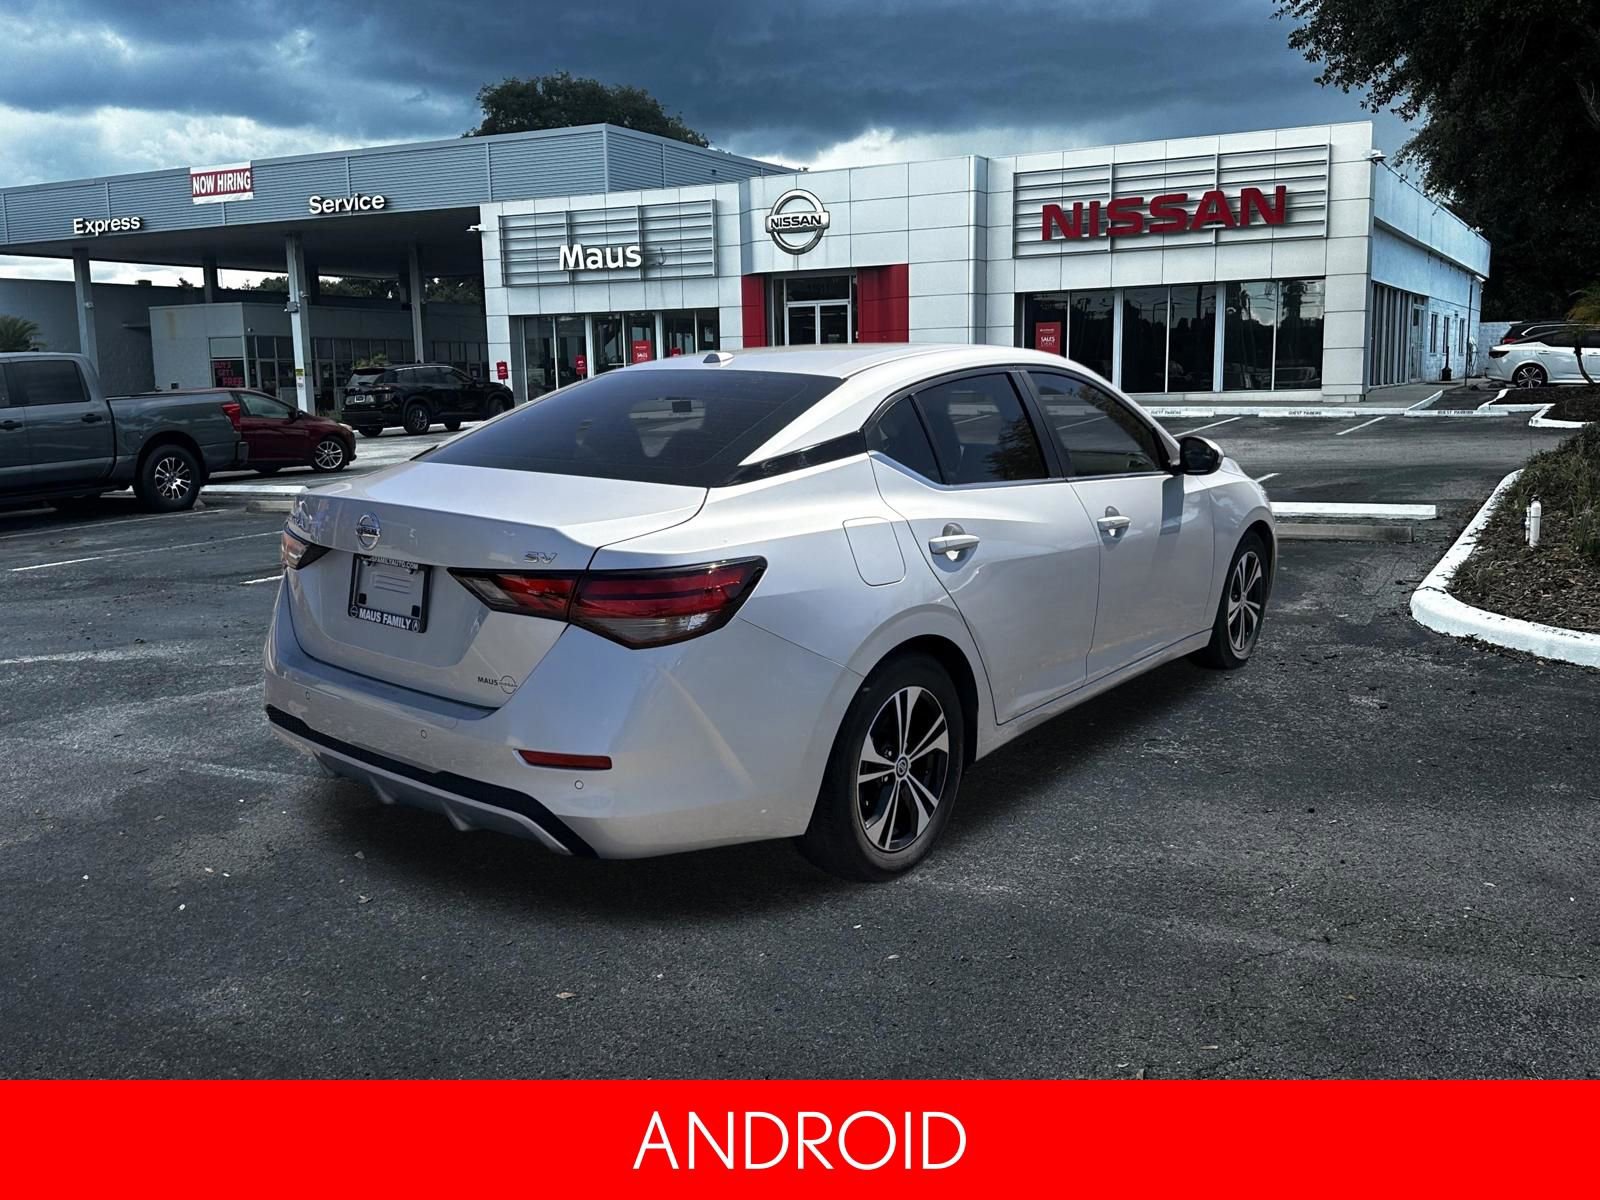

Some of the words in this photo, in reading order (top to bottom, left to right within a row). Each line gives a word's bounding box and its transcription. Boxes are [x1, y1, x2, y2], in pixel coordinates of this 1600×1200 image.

[192, 174, 215, 195] NOW
[217, 170, 251, 193] HIRING
[308, 193, 386, 215] Service
[1041, 185, 1287, 242] NISSAN
[72, 214, 142, 237] Express
[770, 214, 822, 228] NISSAN
[559, 243, 642, 271] Maus
[524, 551, 558, 564] SV
[359, 607, 382, 623] MAUS
[382, 613, 412, 630] FAMILY
[477, 676, 499, 686] MAUS
